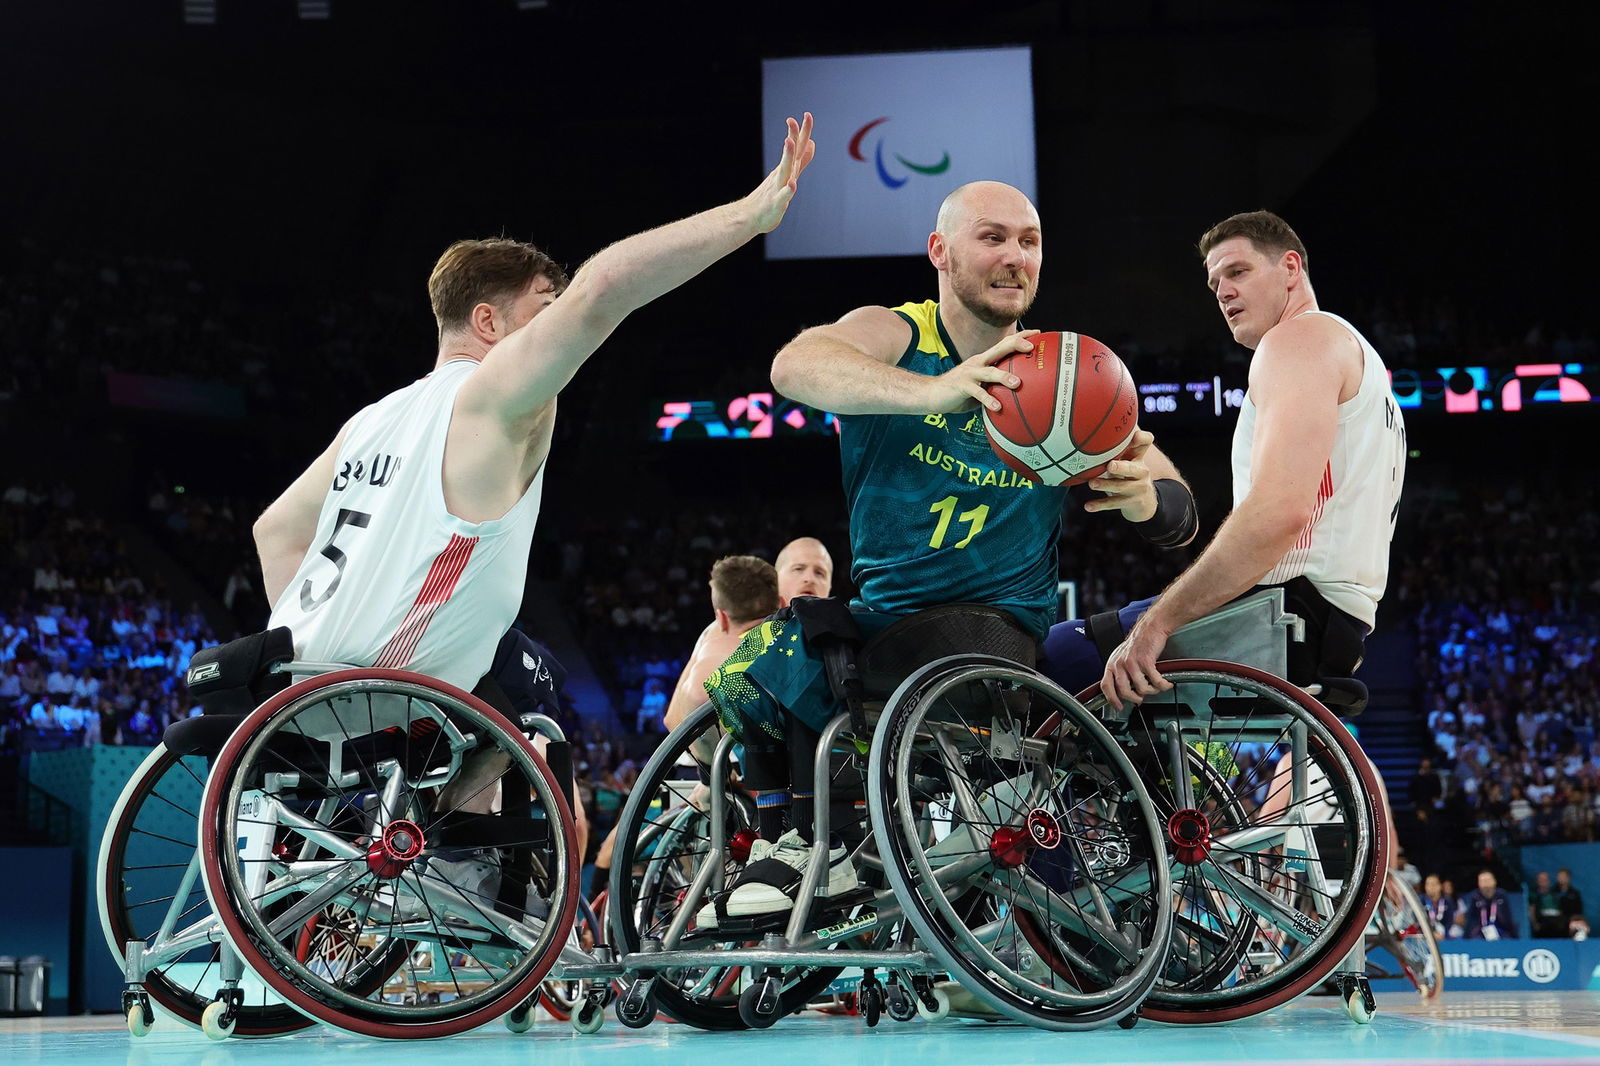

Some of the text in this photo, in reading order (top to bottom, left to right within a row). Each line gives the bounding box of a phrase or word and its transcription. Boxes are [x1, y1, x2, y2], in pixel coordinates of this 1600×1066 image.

[908, 442, 1034, 490] AUSTRALIA
[929, 495, 990, 549] 11
[300, 508, 372, 612] 5
